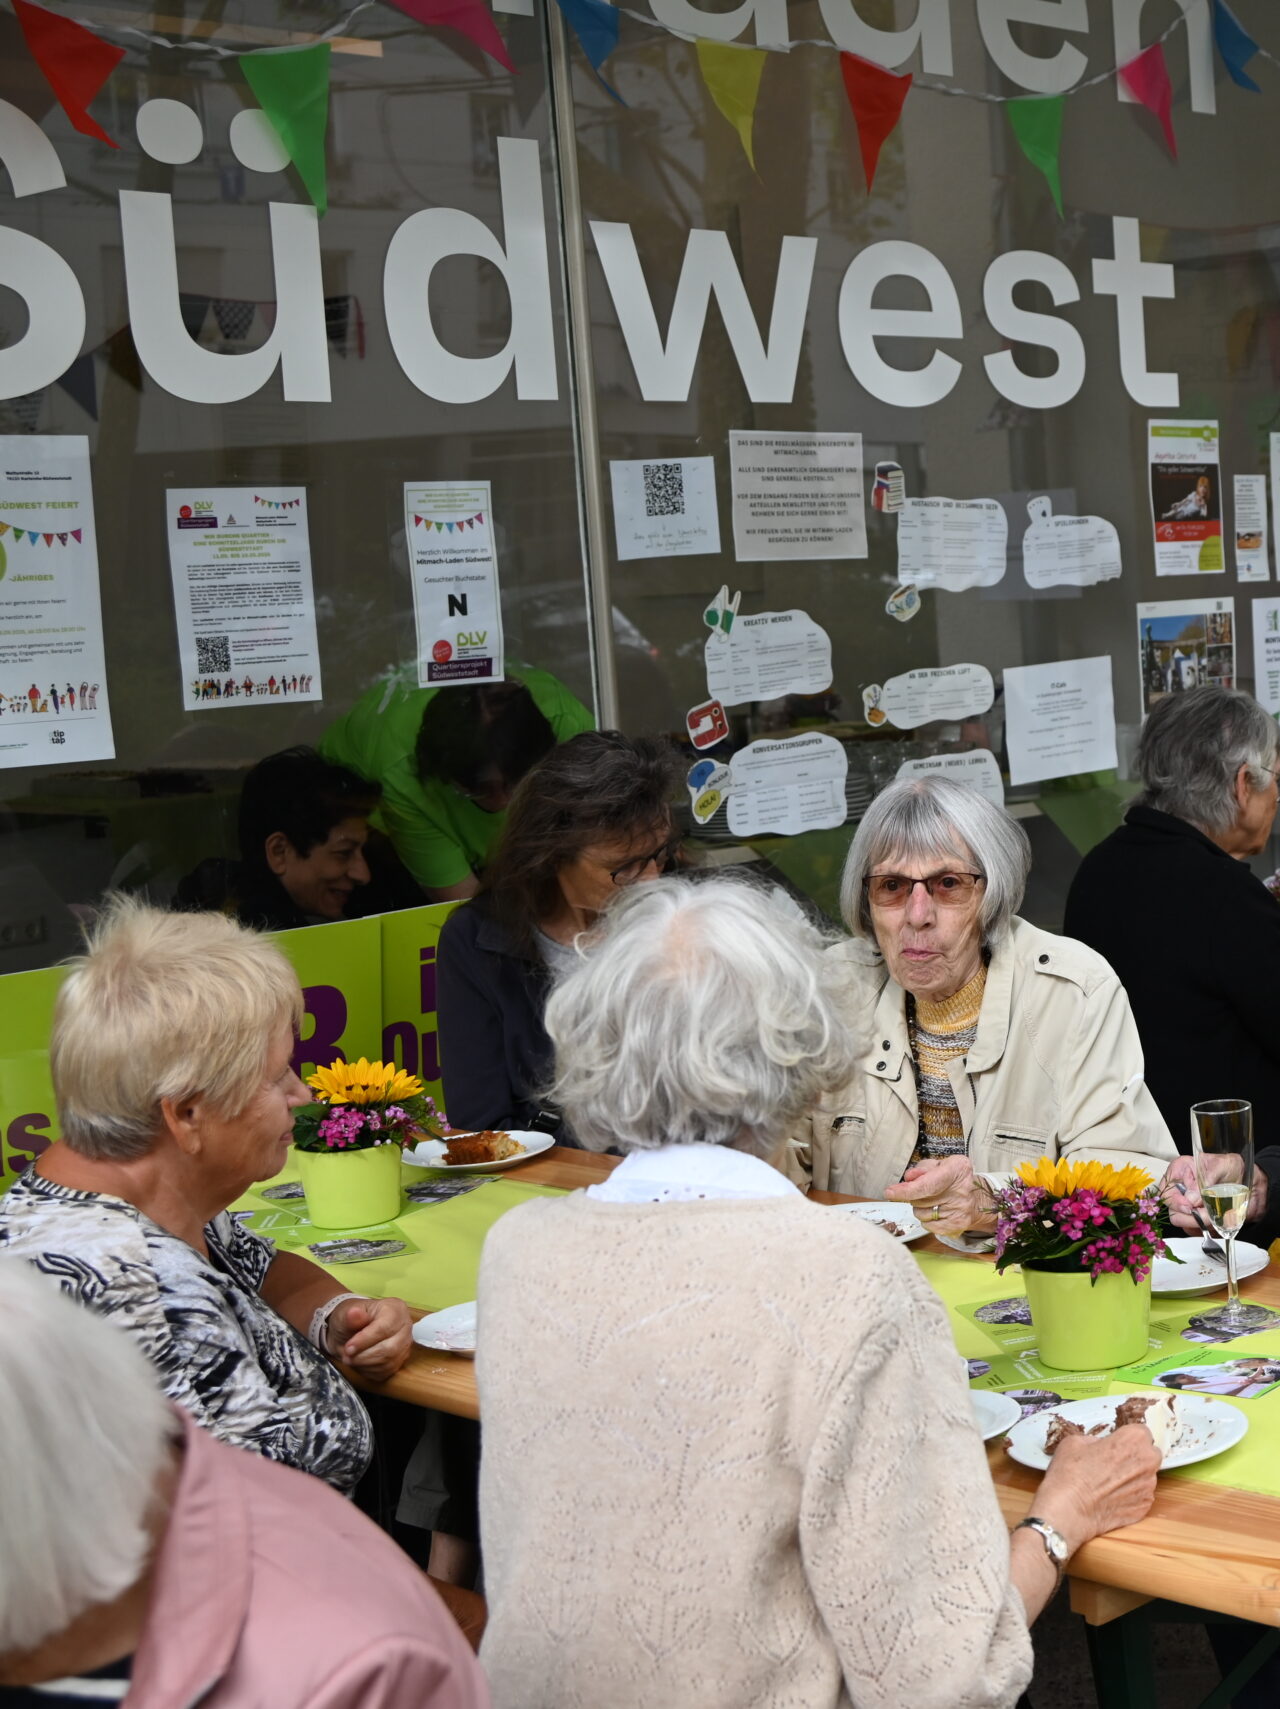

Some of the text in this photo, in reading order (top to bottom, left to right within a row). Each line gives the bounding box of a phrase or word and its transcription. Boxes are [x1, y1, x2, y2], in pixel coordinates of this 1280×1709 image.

[46, 501, 80, 509] FEIERT
[447, 593, 468, 617] N
[743, 615, 793, 627] KREATIV WERDEN
[432, 661, 488, 671] Quartiersprojekt
[53, 730, 65, 738] tip
[51, 737, 66, 745] tap
